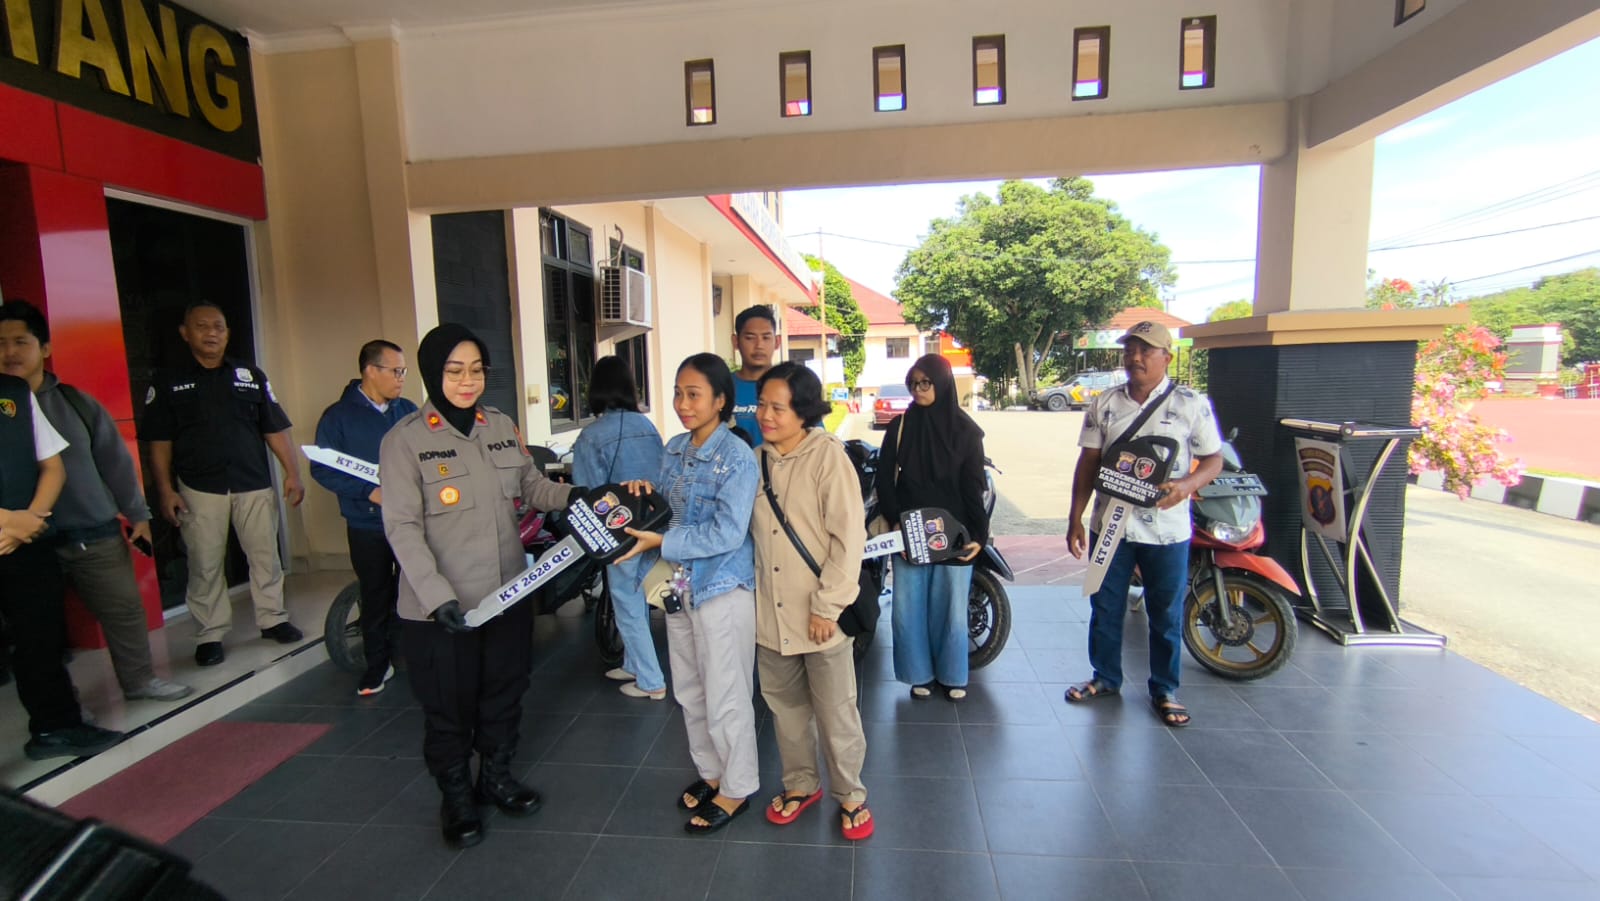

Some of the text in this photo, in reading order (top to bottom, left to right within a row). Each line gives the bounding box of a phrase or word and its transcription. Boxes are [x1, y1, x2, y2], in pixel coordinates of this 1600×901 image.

[336, 456, 376, 476] KT 3753
[1098, 473, 1157, 499] BARANG BUKTI
[569, 503, 612, 553] BARANG BUKTI
[880, 539, 894, 549] QT
[1095, 506, 1124, 566] KT 6785 QB
[498, 548, 571, 603] KT 2628 QC
